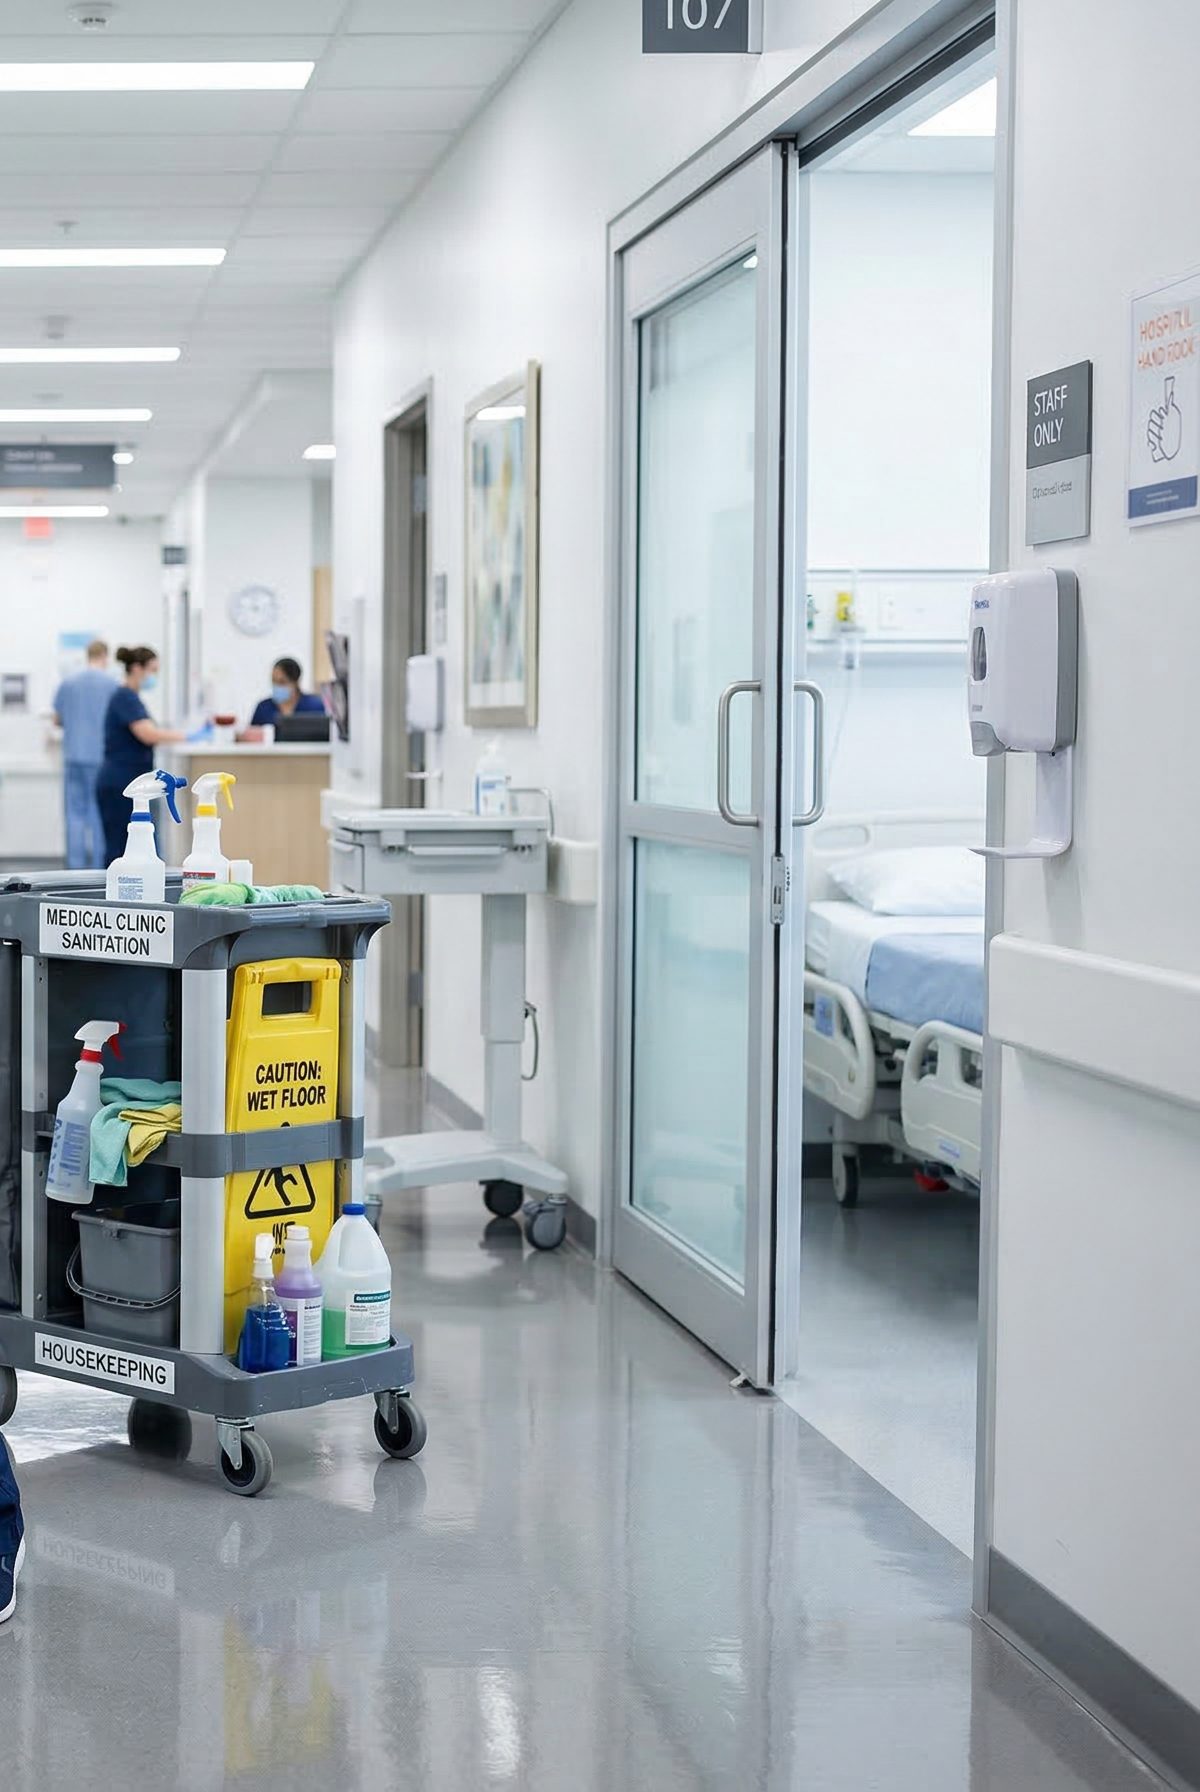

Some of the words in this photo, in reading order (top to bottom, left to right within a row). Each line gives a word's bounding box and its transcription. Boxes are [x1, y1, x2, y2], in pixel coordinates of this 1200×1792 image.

[1034, 384, 1068, 416] STAFF
[1034, 417, 1064, 447] ONLY
[47, 908, 112, 930] MEDICAL
[116, 913, 166, 934] CLINIC
[62, 932, 150, 956] SANITATION
[256, 1060, 322, 1085] CAUTION:
[247, 1090, 278, 1111] WET
[281, 1085, 326, 1108] FLOOR
[42, 1340, 167, 1385] HOUSEKEEPING
